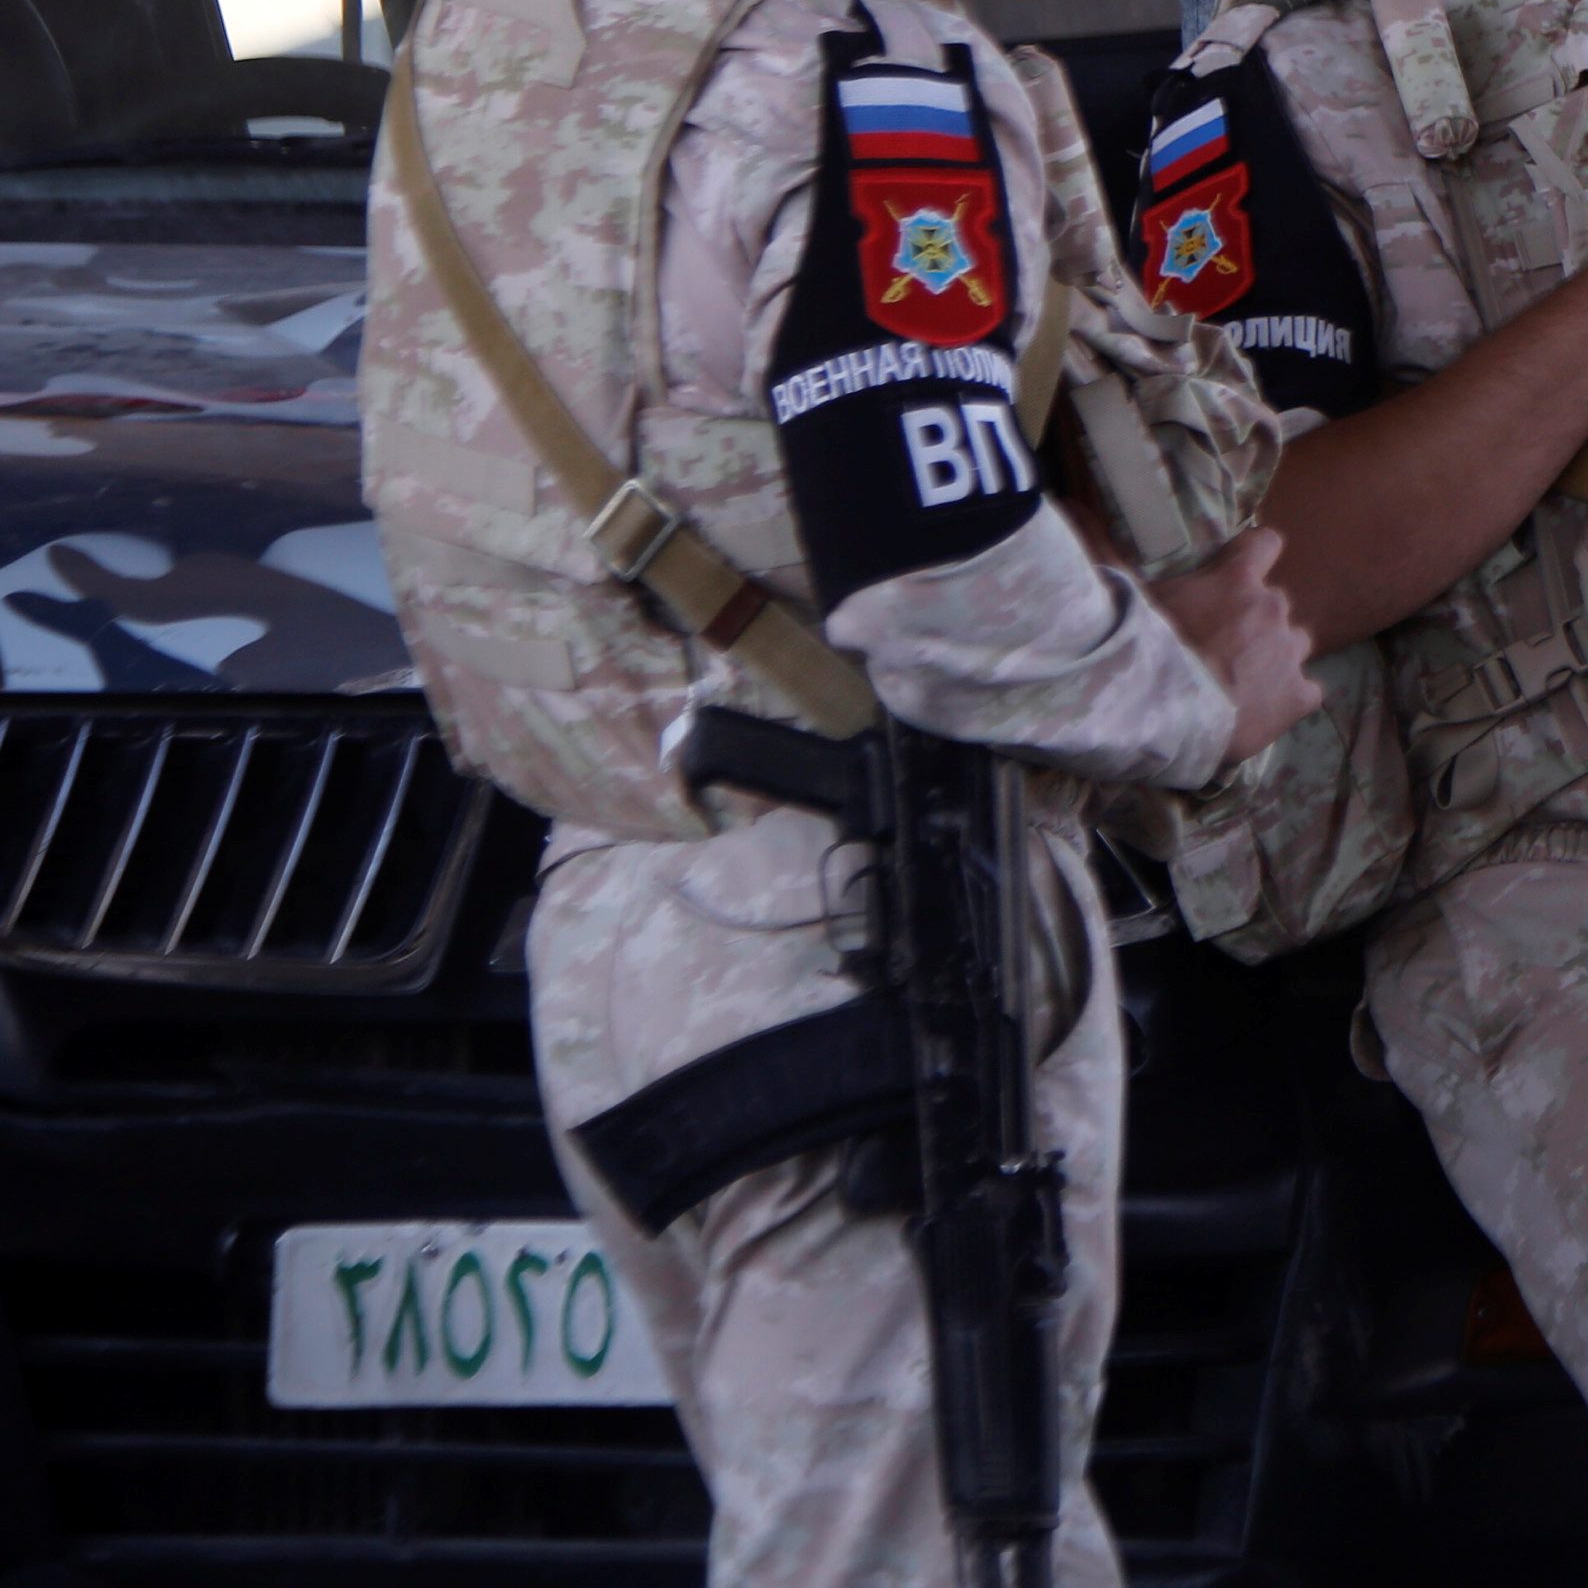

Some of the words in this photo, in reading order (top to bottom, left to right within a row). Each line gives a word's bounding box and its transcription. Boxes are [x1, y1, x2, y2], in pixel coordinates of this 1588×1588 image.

[1223, 314, 1351, 364] ОЛИЦИЯ
[771, 340, 930, 425] ВОЕННАЯ
[901, 404, 1037, 507] ВП
